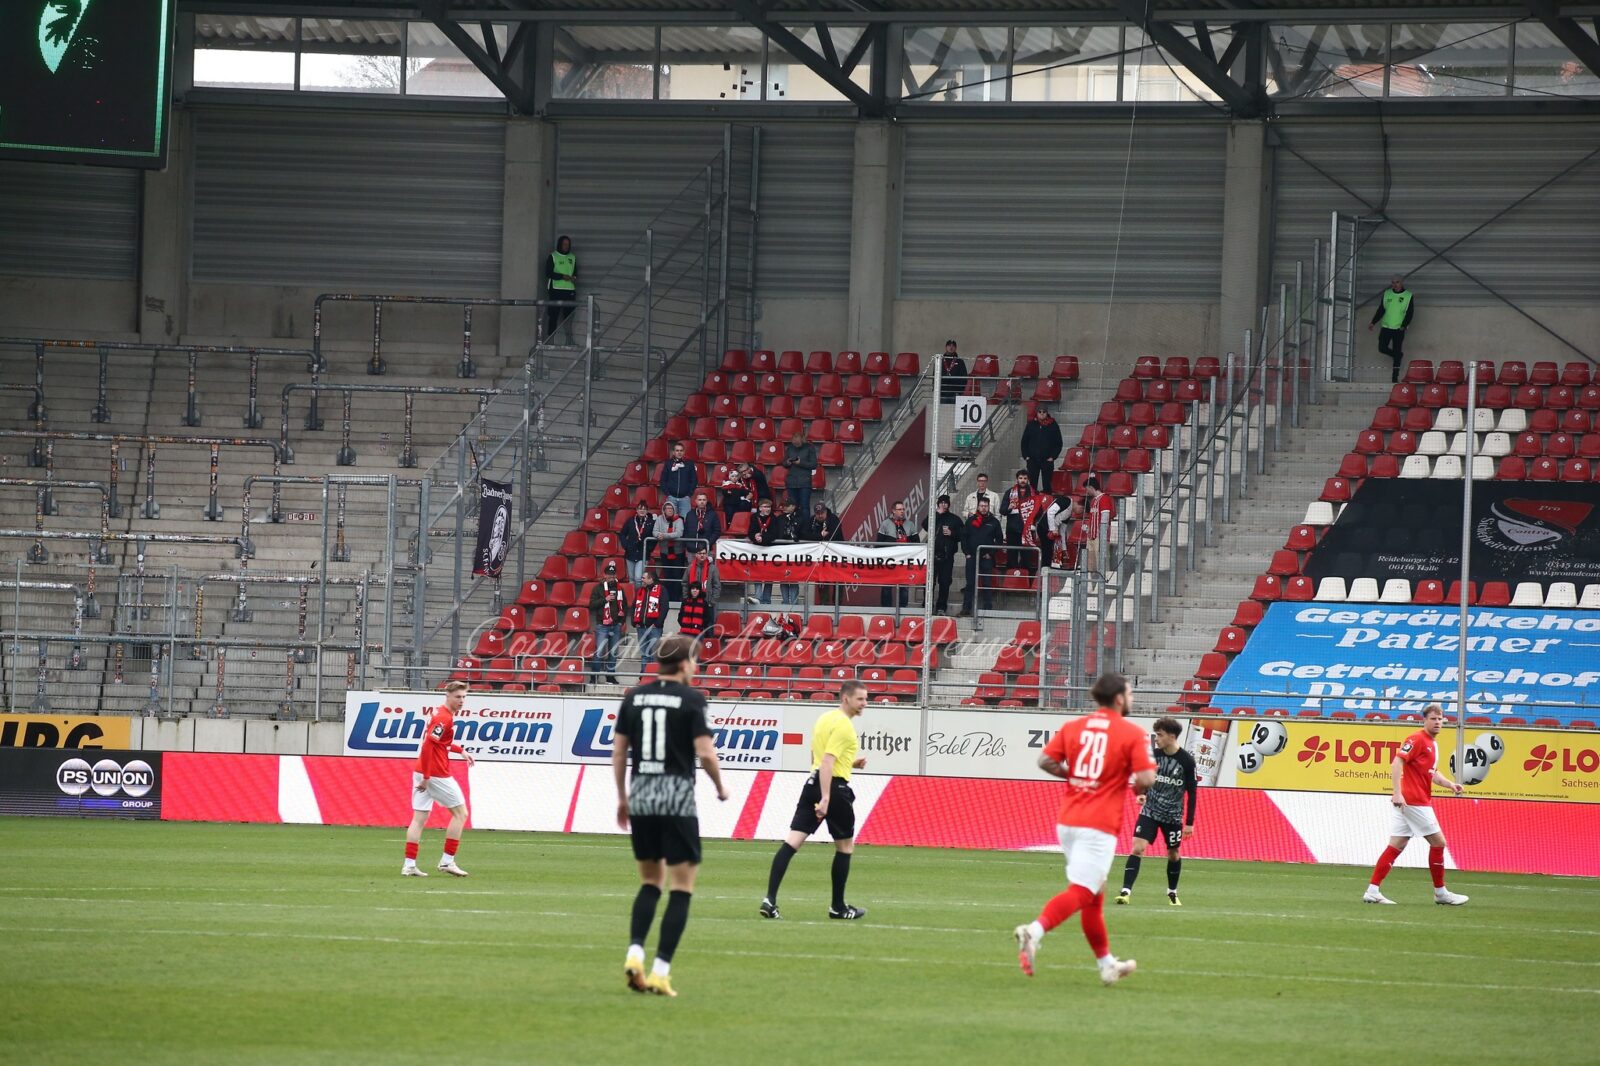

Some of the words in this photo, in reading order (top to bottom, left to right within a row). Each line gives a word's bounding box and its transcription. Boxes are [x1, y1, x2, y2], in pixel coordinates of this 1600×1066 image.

[960, 404, 982, 424] 10
[822, 554, 896, 570] FREIBURG
[1336, 628, 1563, 654] Patzner
[1259, 661, 1600, 687] Getränkehof
[1301, 682, 1529, 715] Patzner
[641, 707, 667, 761] 11
[1252, 723, 1270, 744] 19
[487, 745, 546, 756] Saline
[925, 732, 967, 757] Edel
[961, 731, 1008, 758] Pils
[1073, 730, 1110, 780] 28
[1335, 739, 1402, 764] LOTT
[1238, 752, 1257, 769] 15
[1464, 748, 1488, 767] 49
[1562, 748, 1600, 773] LO
[63, 771, 88, 784] PS
[93, 771, 148, 785] UNION
[122, 800, 154, 808] GROUP
[1168, 830, 1182, 843] 22
